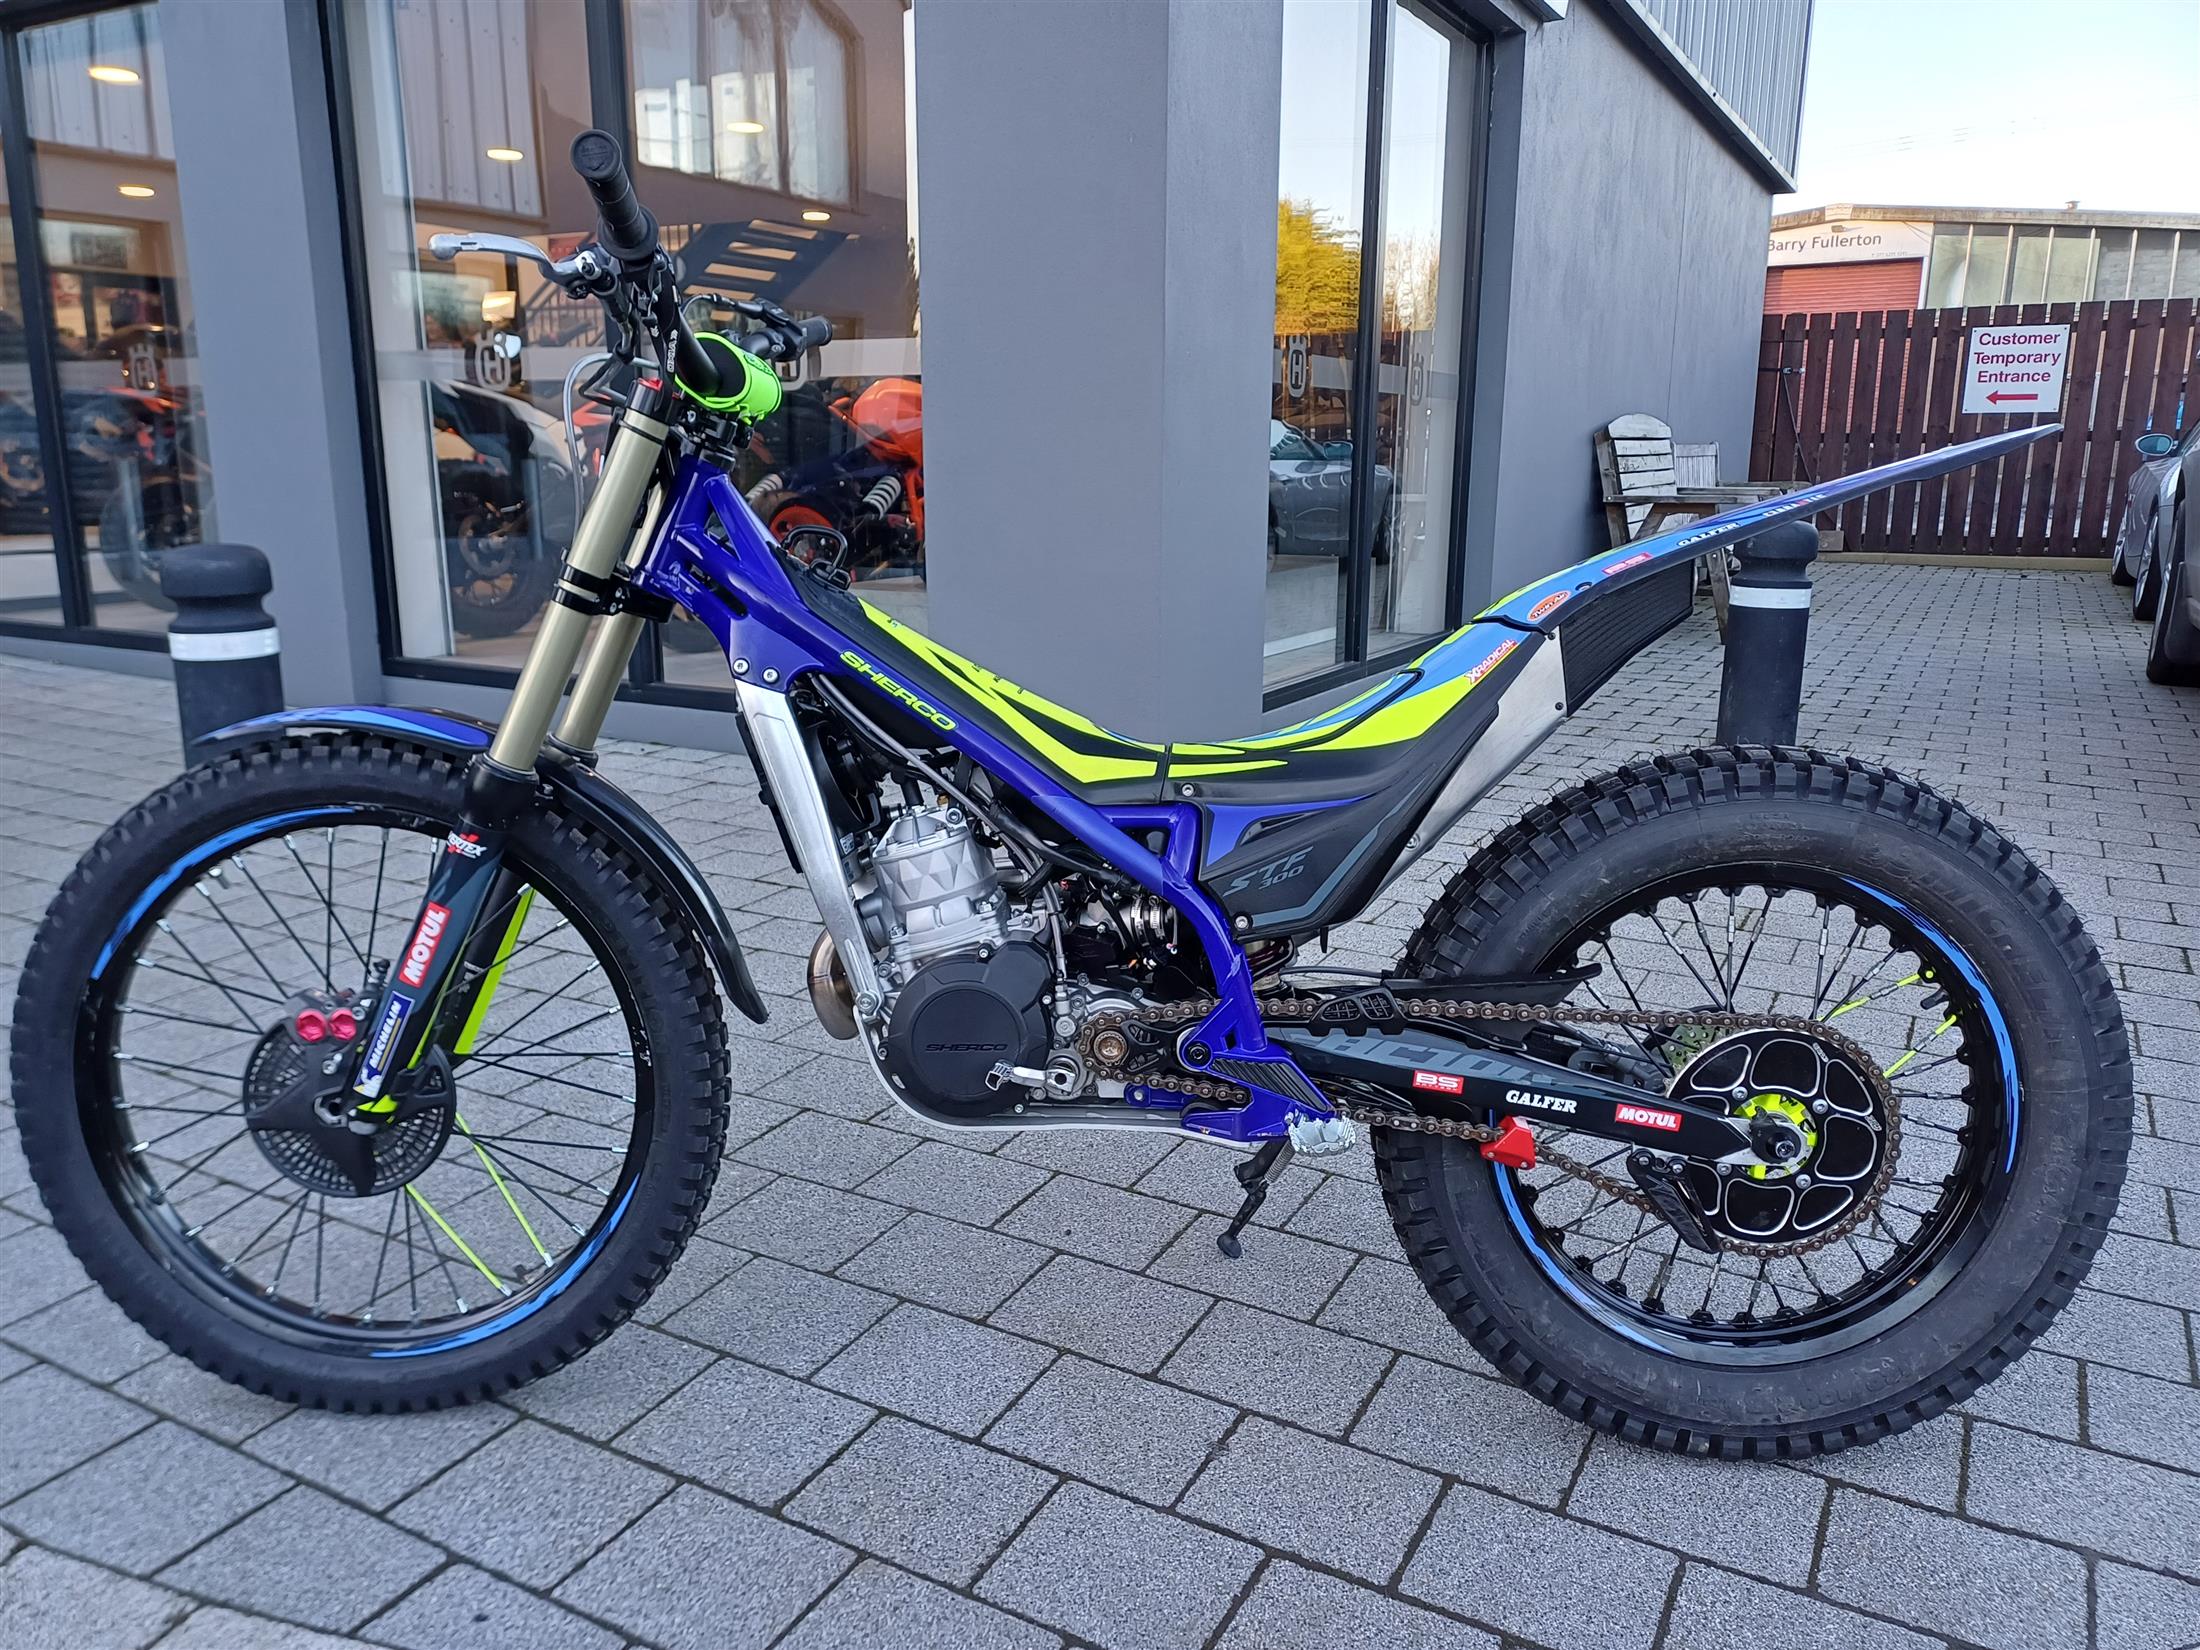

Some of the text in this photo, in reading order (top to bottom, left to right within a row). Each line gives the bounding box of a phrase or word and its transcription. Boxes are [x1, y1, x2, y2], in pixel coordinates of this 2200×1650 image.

[1768, 233, 1882, 253] Barry Fullerton
[1979, 332, 2061, 346] Customer
[1973, 351, 2062, 367] Temporary
[1977, 370, 2051, 383] Entrance
[839, 650, 957, 731] SHERCO
[1258, 865, 1304, 890] 300
[403, 908, 447, 986] MOTUL
[368, 999, 402, 1070] MICHELIN
[925, 1043, 1009, 1052] SHERCO
[1415, 1072, 1459, 1089] BS
[1505, 1089, 1577, 1114] GALFER
[1618, 1106, 1677, 1128] MOTUL
